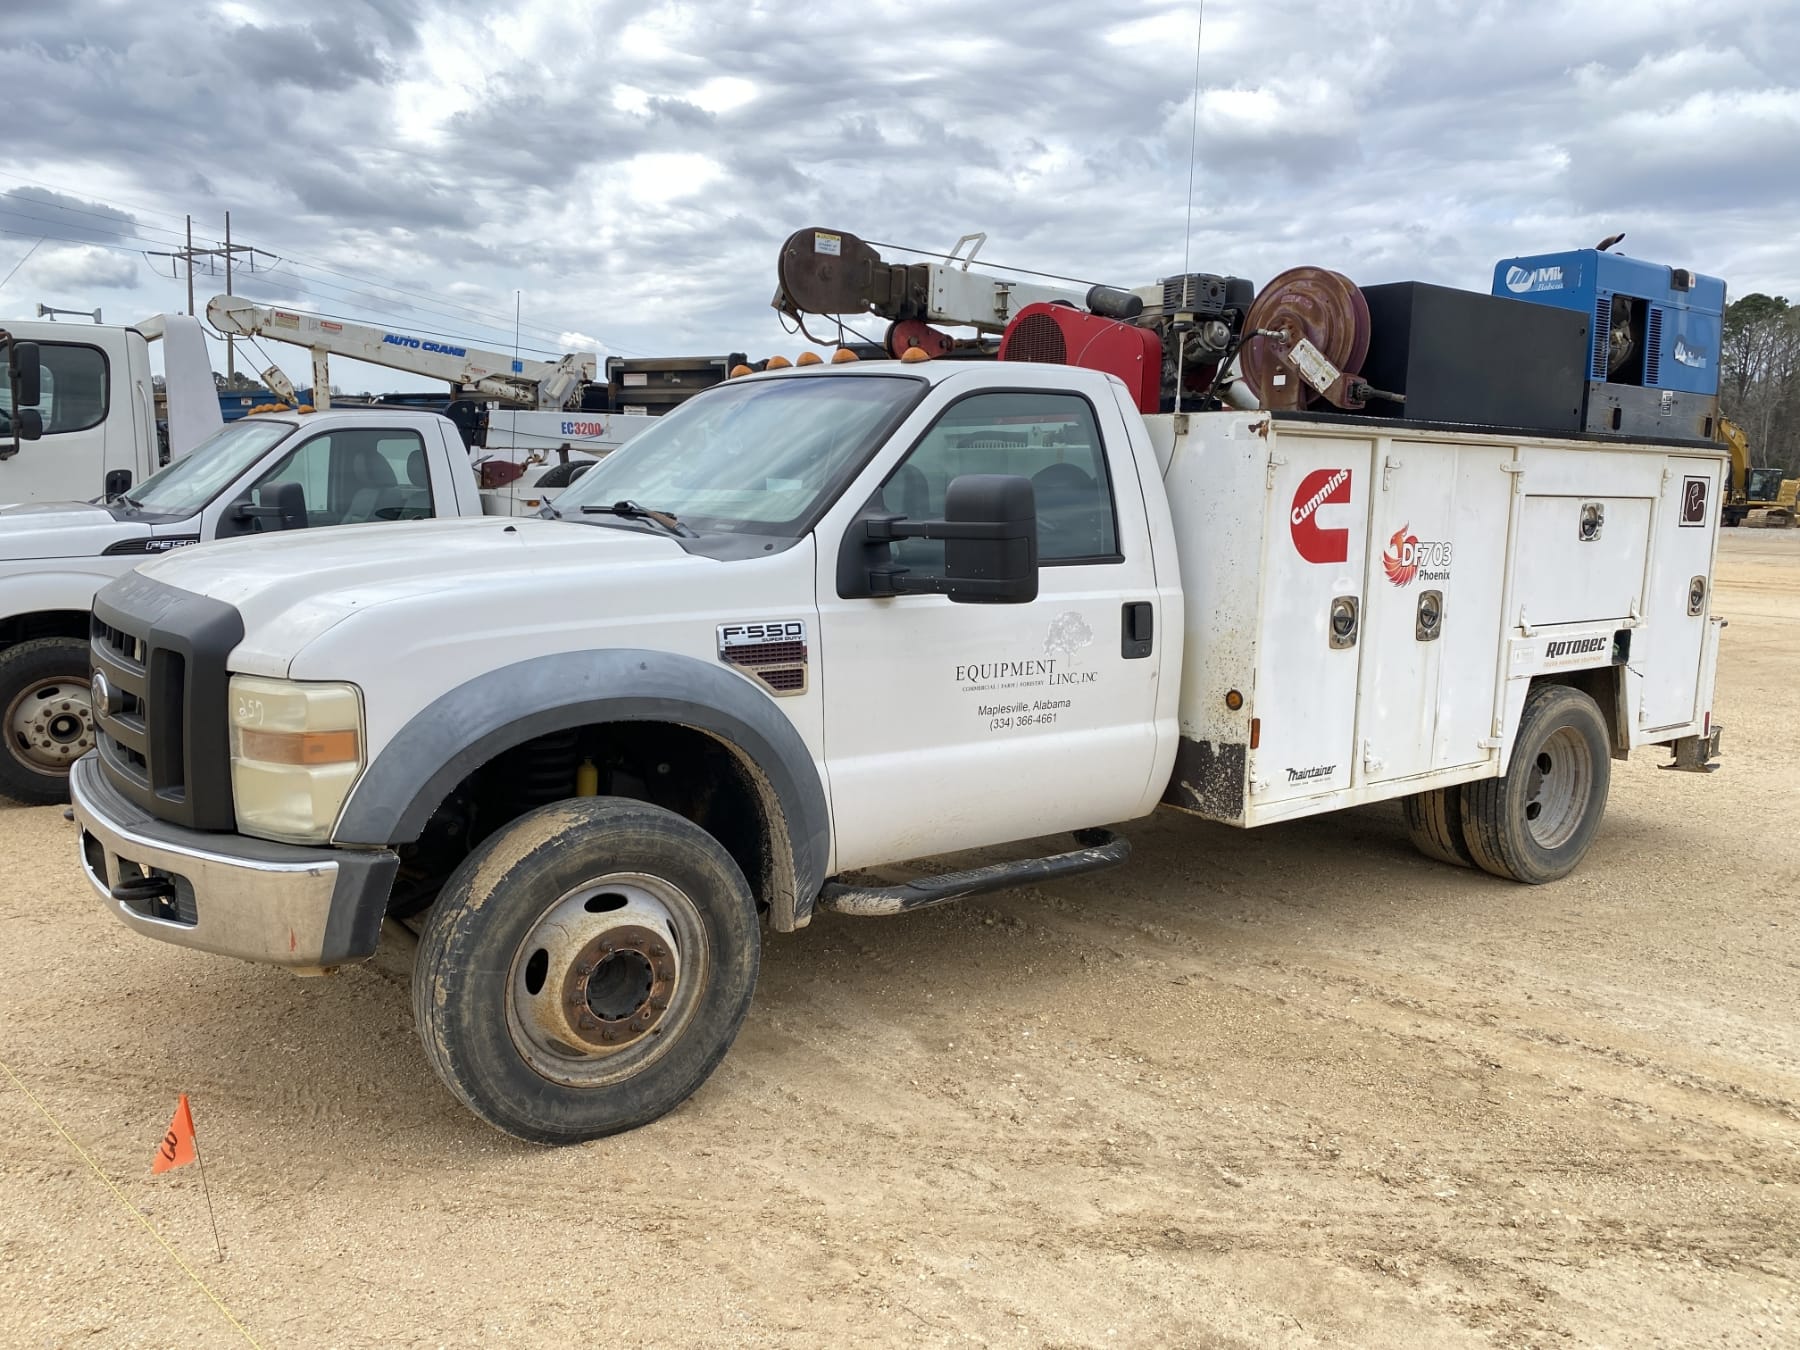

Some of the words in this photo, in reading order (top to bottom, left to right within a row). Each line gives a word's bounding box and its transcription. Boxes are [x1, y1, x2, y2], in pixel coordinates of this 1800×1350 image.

[383, 334, 420, 348] AUTO
[422, 342, 466, 357] CRANE
[561, 422, 602, 435] EC3200
[1292, 468, 1348, 525] Cummins
[1401, 541, 1453, 567] DF703
[1419, 569, 1450, 580] Phoenix
[1545, 637, 1607, 658] ROTOBEC
[956, 659, 1057, 682] EQUIPMENT
[1081, 671, 1098, 682] INC
[978, 701, 1031, 716] Maplesville,
[1033, 699, 1071, 711] Alabama
[990, 717, 1014, 732] (334)
[1016, 713, 1057, 727] 366-4661
[1285, 765, 1337, 781] Maintainer
